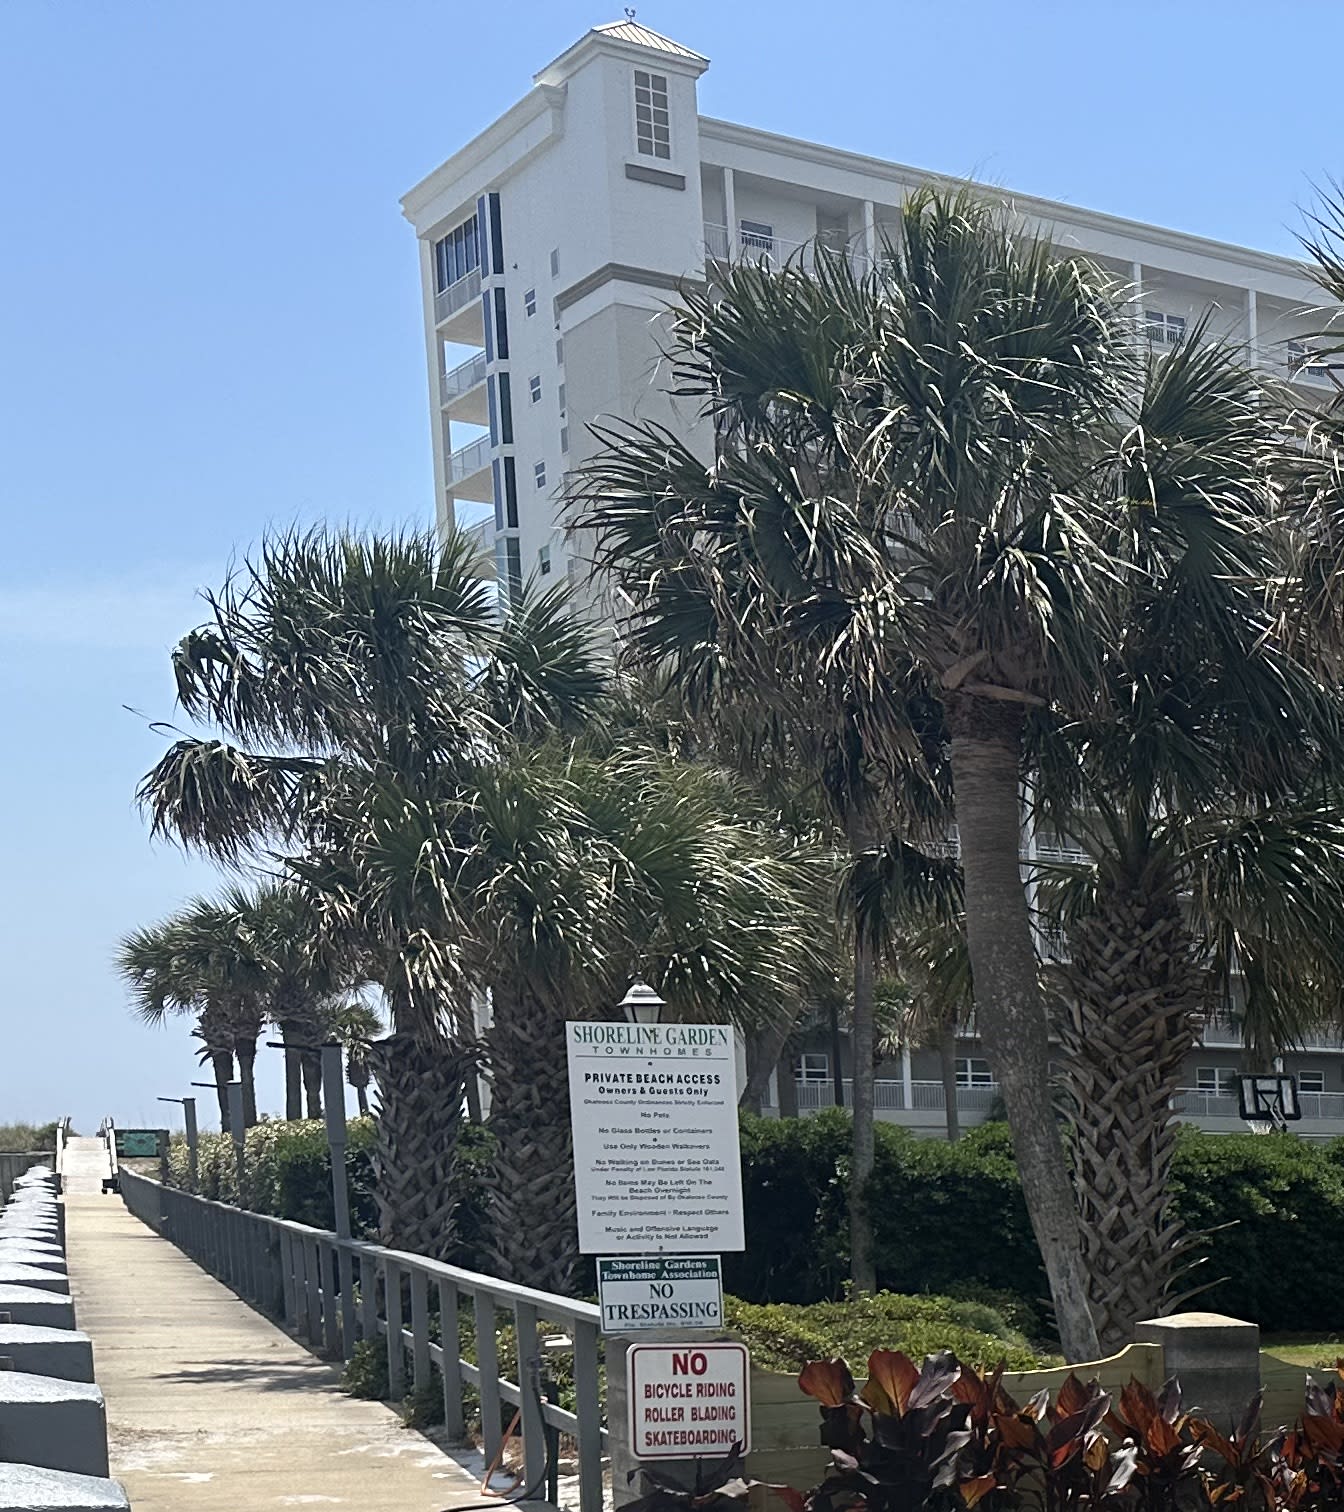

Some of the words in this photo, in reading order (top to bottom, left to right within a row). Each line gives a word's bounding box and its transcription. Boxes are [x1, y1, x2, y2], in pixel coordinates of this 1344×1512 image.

[574, 1026, 662, 1045] SHORELINE
[666, 1027, 728, 1046] GARDEN
[585, 1073, 633, 1083] PRIVATE
[636, 1074, 674, 1083] BEACH
[677, 1074, 721, 1084] ACCESS
[598, 1086, 637, 1094] Owners
[649, 1087, 684, 1095] Guests
[686, 1087, 708, 1097] Only
[611, 1261, 660, 1270] Shoreline
[664, 1260, 707, 1269] Gardens
[602, 1271, 656, 1280] Townhome
[661, 1270, 718, 1279] Association
[649, 1283, 674, 1299] NO
[605, 1302, 718, 1320] TRESPASSING
[672, 1353, 707, 1375] NO
[644, 1383, 693, 1399] BICYCLE
[696, 1382, 736, 1398] RIDING
[645, 1407, 684, 1423] ROLLER
[691, 1405, 736, 1421] BLADING
[645, 1429, 736, 1447] SKATEBOARDING
